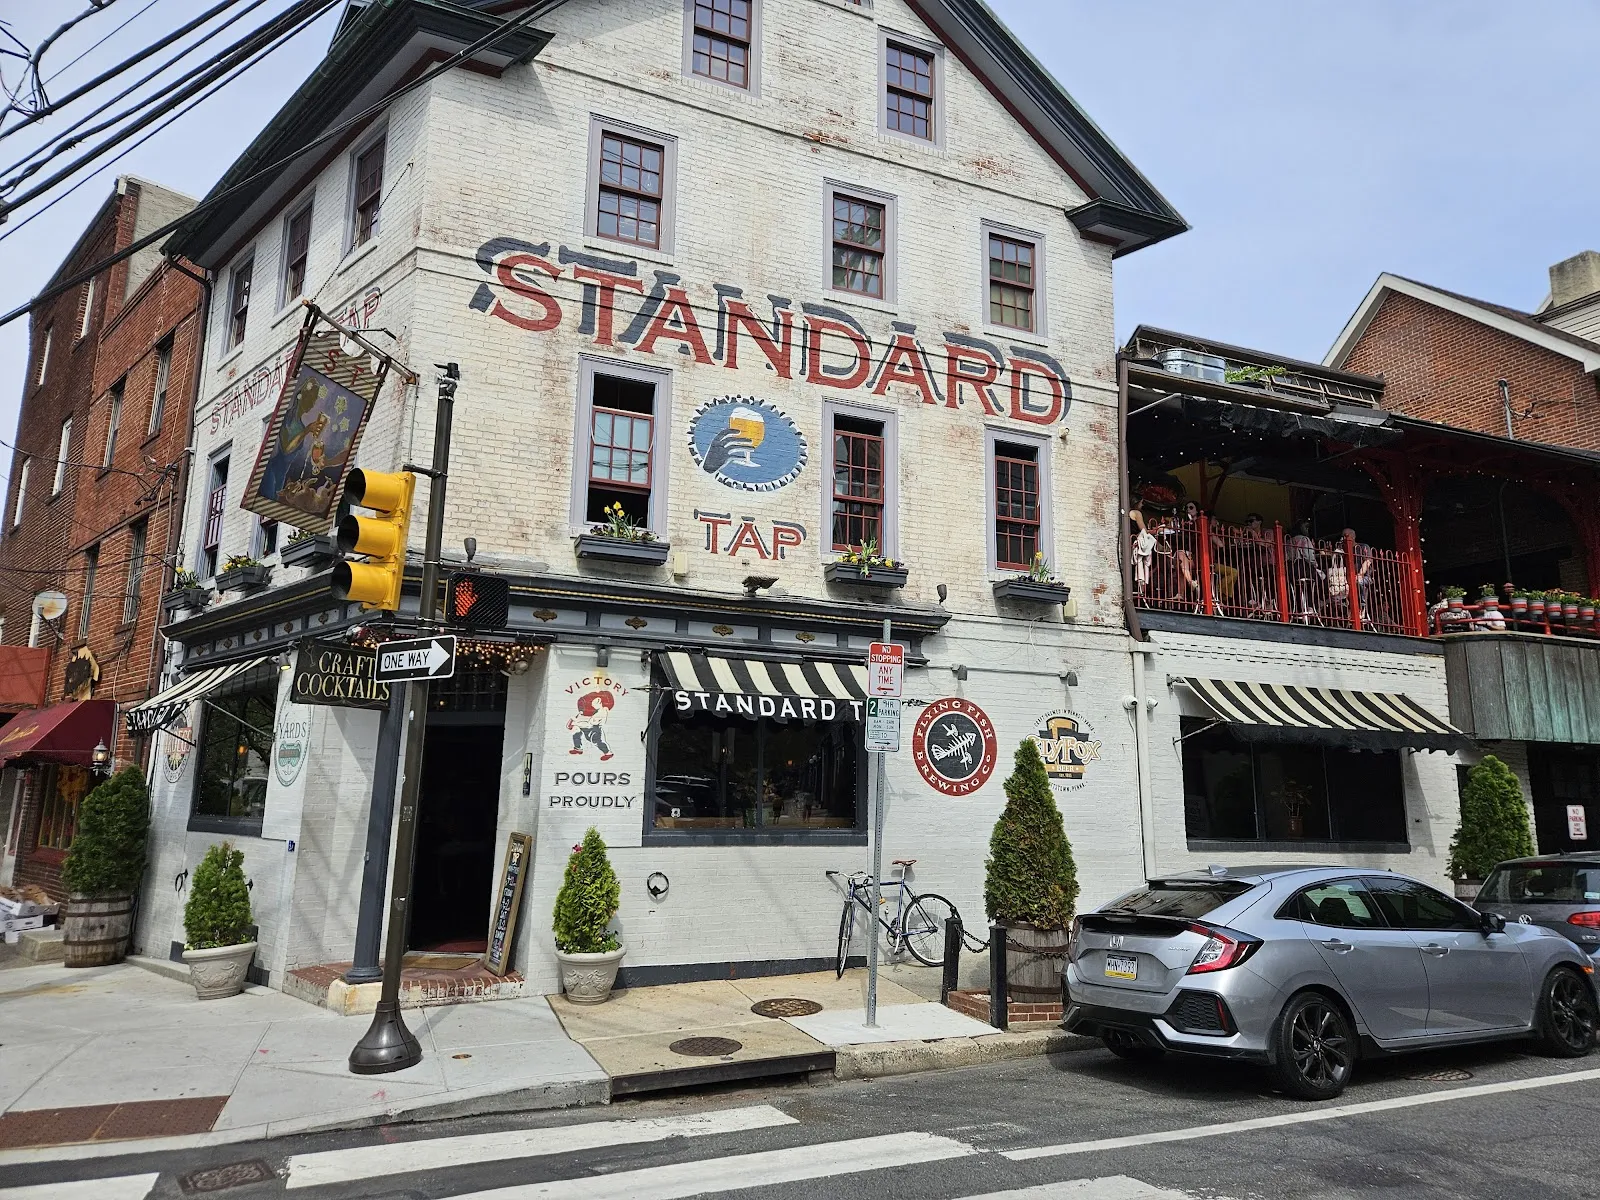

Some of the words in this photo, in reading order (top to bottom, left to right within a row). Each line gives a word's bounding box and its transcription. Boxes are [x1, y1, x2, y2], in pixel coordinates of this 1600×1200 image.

[469, 236, 1072, 426] STANDARD
[323, 349, 341, 374] S
[351, 364, 365, 388] T
[693, 508, 807, 561] TAP
[881, 645, 892, 654] NO
[319, 650, 376, 677] CRAFT
[384, 653, 404, 669] ONE
[408, 651, 430, 667] WAY
[871, 654, 901, 664] STOPPING
[878, 666, 894, 674] ANY
[297, 672, 390, 701] COCKTAILS
[564, 676, 629, 697] VICTORY
[877, 675, 894, 685] TIME
[675, 690, 836, 720] STANDARD
[869, 701, 876, 715] 2
[878, 708, 899, 717] PARKING
[917, 700, 962, 738] FLYING
[967, 705, 993, 739] FISH
[278, 722, 307, 739] YARDS
[554, 772, 632, 787] POURS
[917, 752, 979, 793] BREWING
[549, 796, 636, 809] PROUDLY
